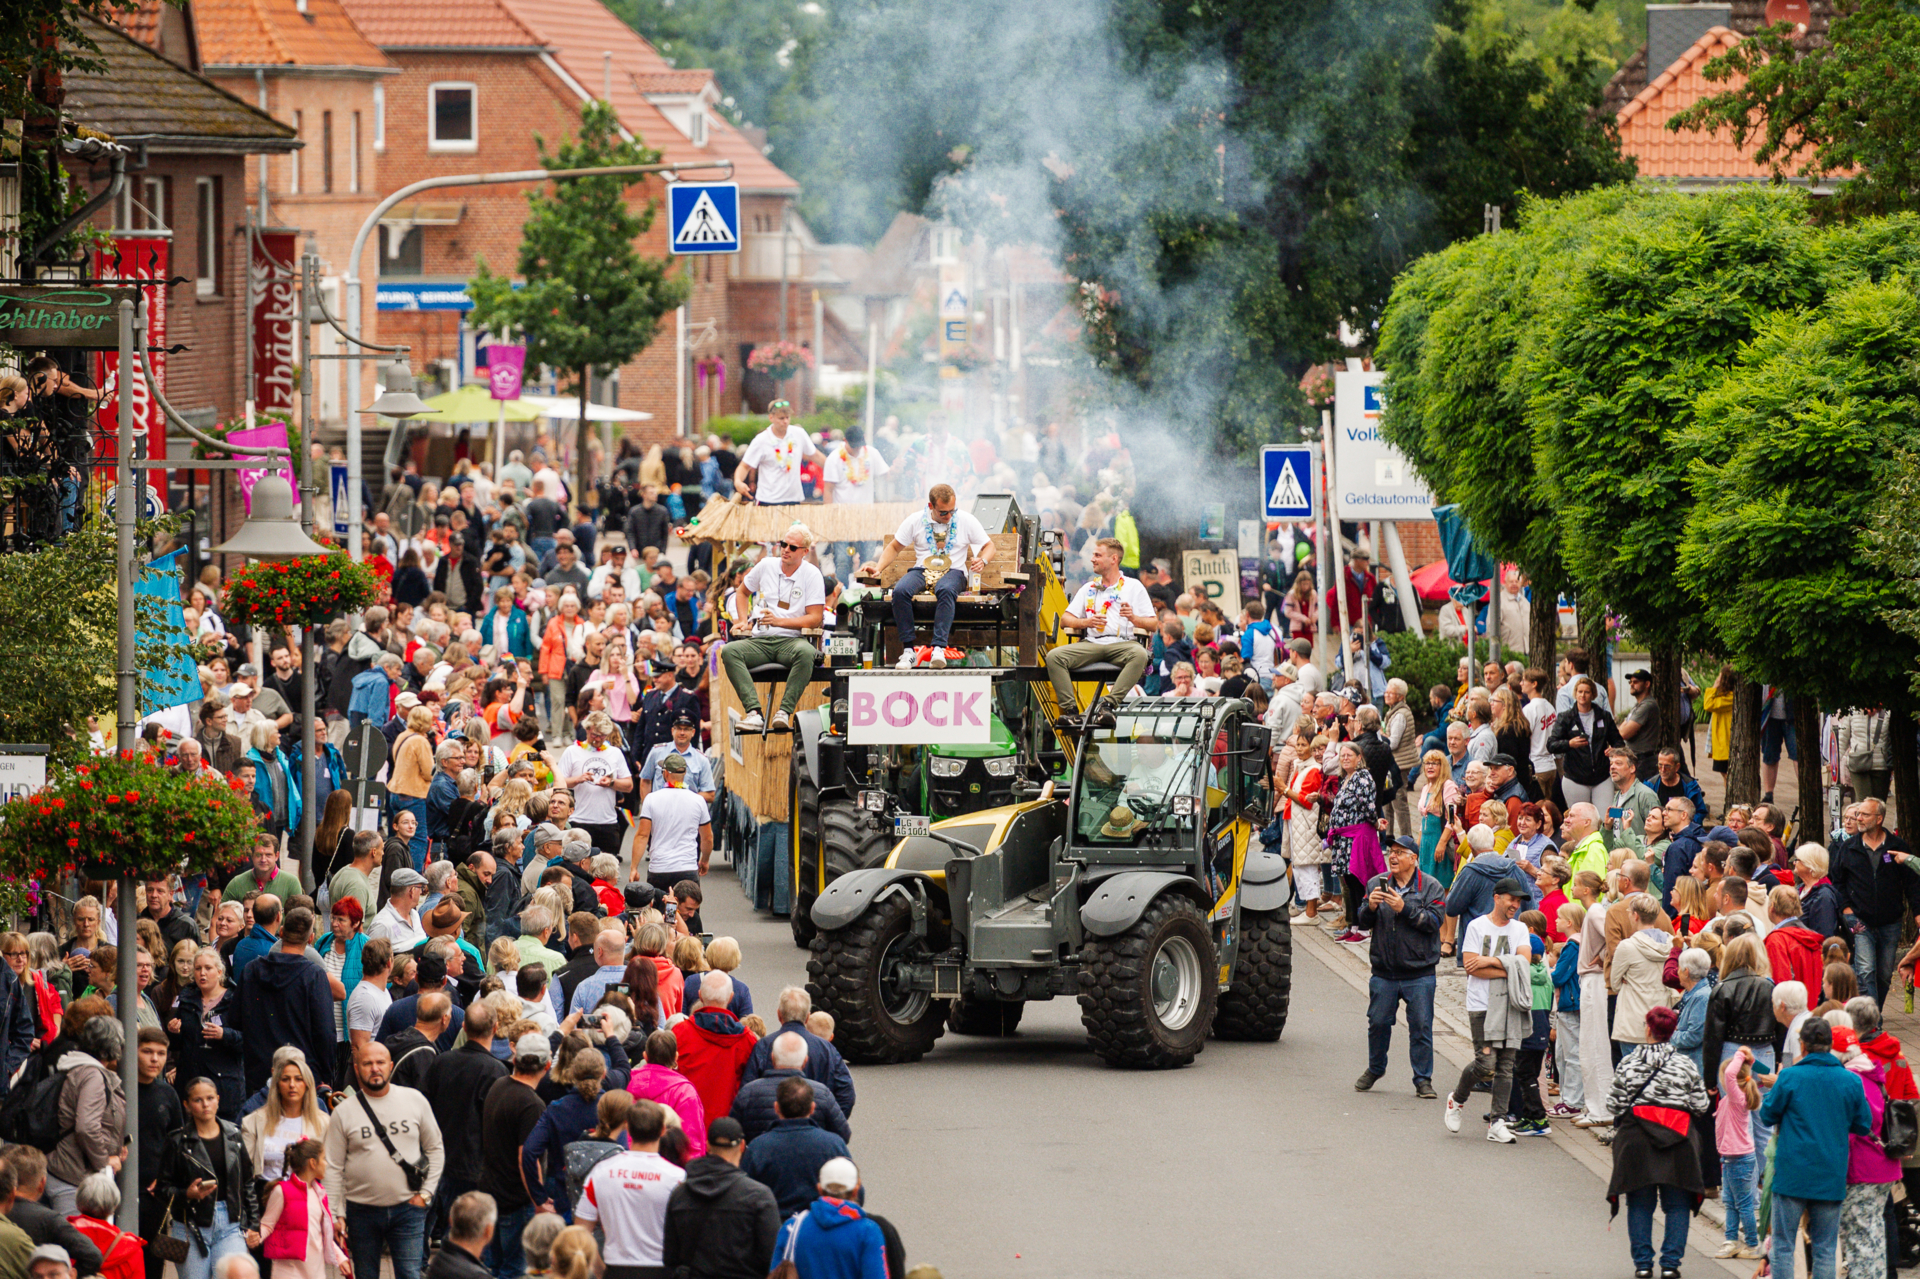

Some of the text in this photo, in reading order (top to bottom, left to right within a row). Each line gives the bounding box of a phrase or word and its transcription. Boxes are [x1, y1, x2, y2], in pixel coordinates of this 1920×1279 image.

[0, 305, 112, 330] ehlhaber
[1346, 427, 1382, 441] Volk
[1345, 492, 1430, 505] Geldautomat
[1189, 557, 1231, 575] Antik
[833, 639, 844, 647] LG
[852, 691, 984, 728] BOCK
[901, 819, 912, 827] LG
[896, 827, 928, 836] AG 1001
[361, 1120, 410, 1139] BSS
[617, 1168, 629, 1179] FC
[631, 1170, 662, 1181] UNION
